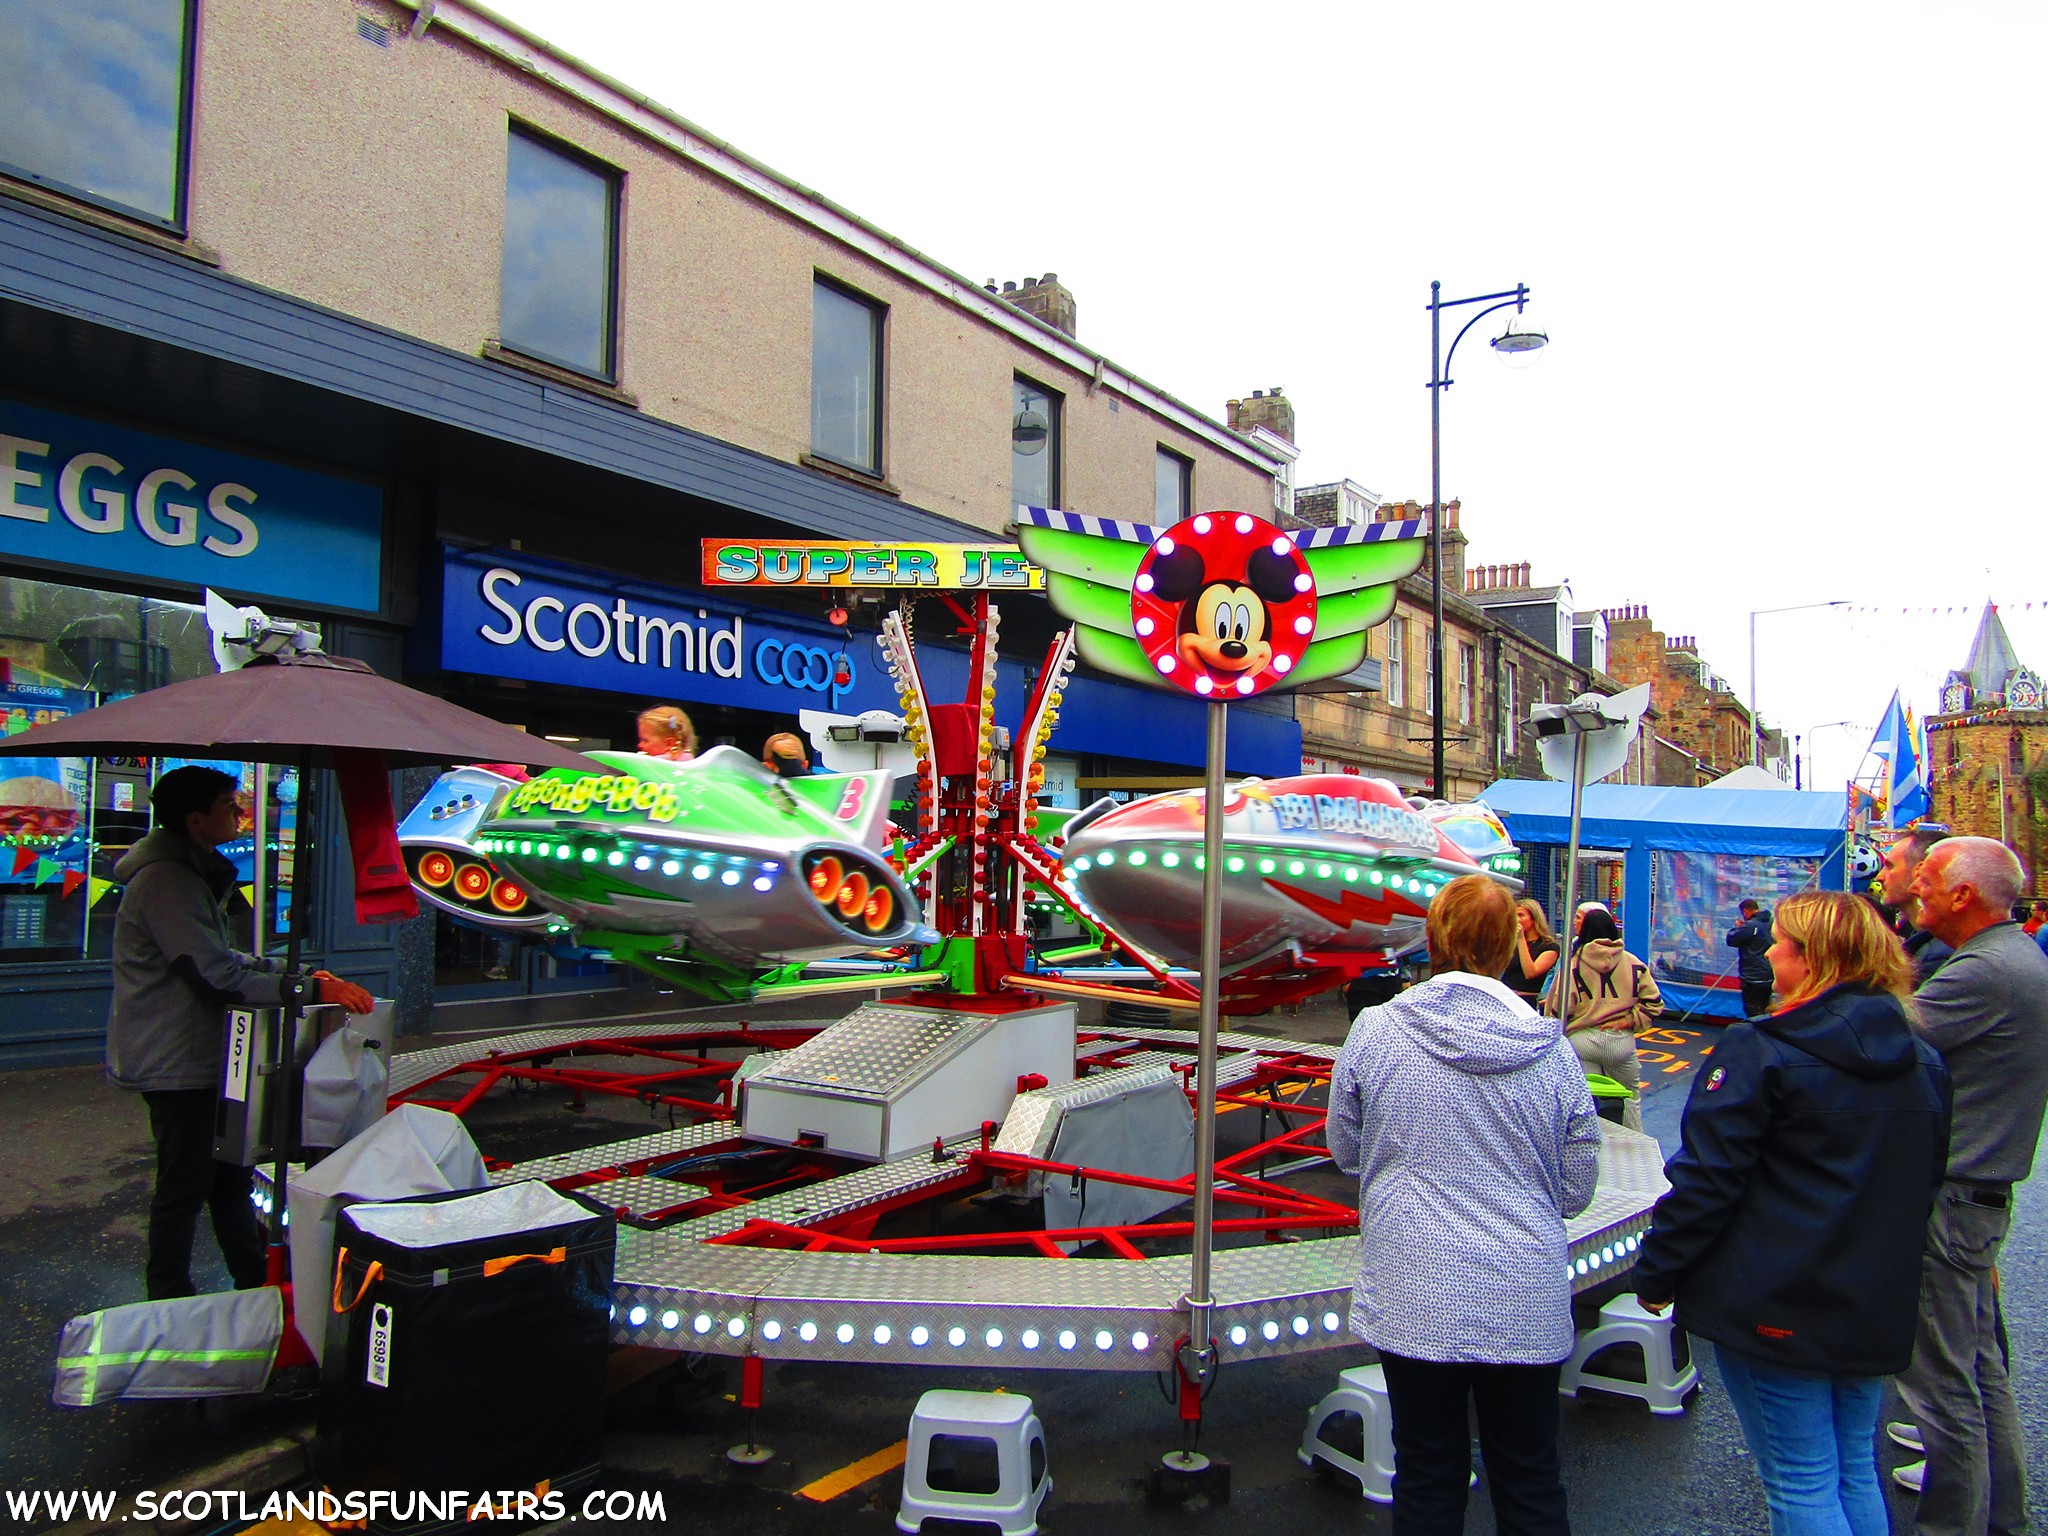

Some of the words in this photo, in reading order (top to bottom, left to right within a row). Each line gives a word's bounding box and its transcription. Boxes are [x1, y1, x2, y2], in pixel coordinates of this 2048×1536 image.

[0, 434, 260, 558] EGGS
[716, 547, 938, 585] SUPER
[480, 567, 742, 680] Scotmid
[18, 685, 61, 696] GREGGS
[834, 776, 867, 822] 3
[234, 1015, 246, 1078] S51
[373, 1330, 387, 1364] 6598
